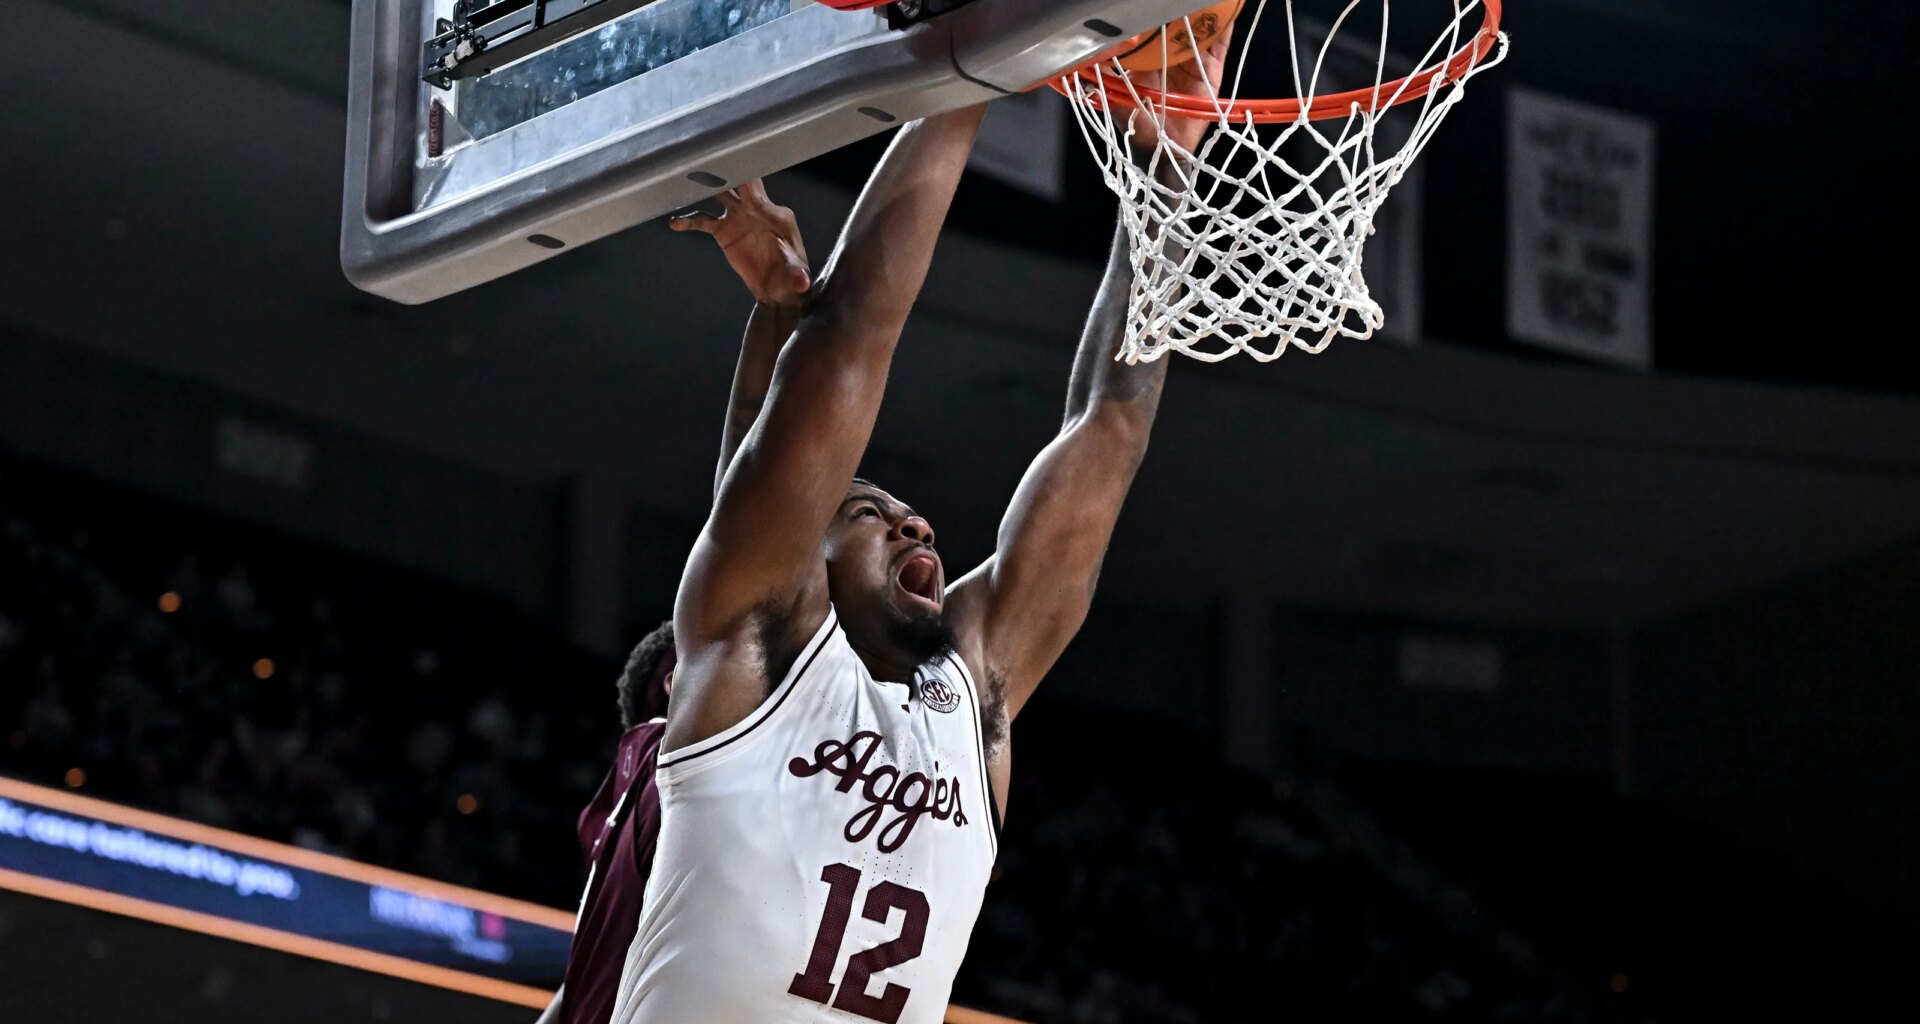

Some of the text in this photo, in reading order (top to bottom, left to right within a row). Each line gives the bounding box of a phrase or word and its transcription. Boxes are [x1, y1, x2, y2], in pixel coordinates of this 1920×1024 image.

[923, 680, 951, 703] SEC
[788, 731, 968, 854] Aggies
[787, 862, 931, 1024] 12
